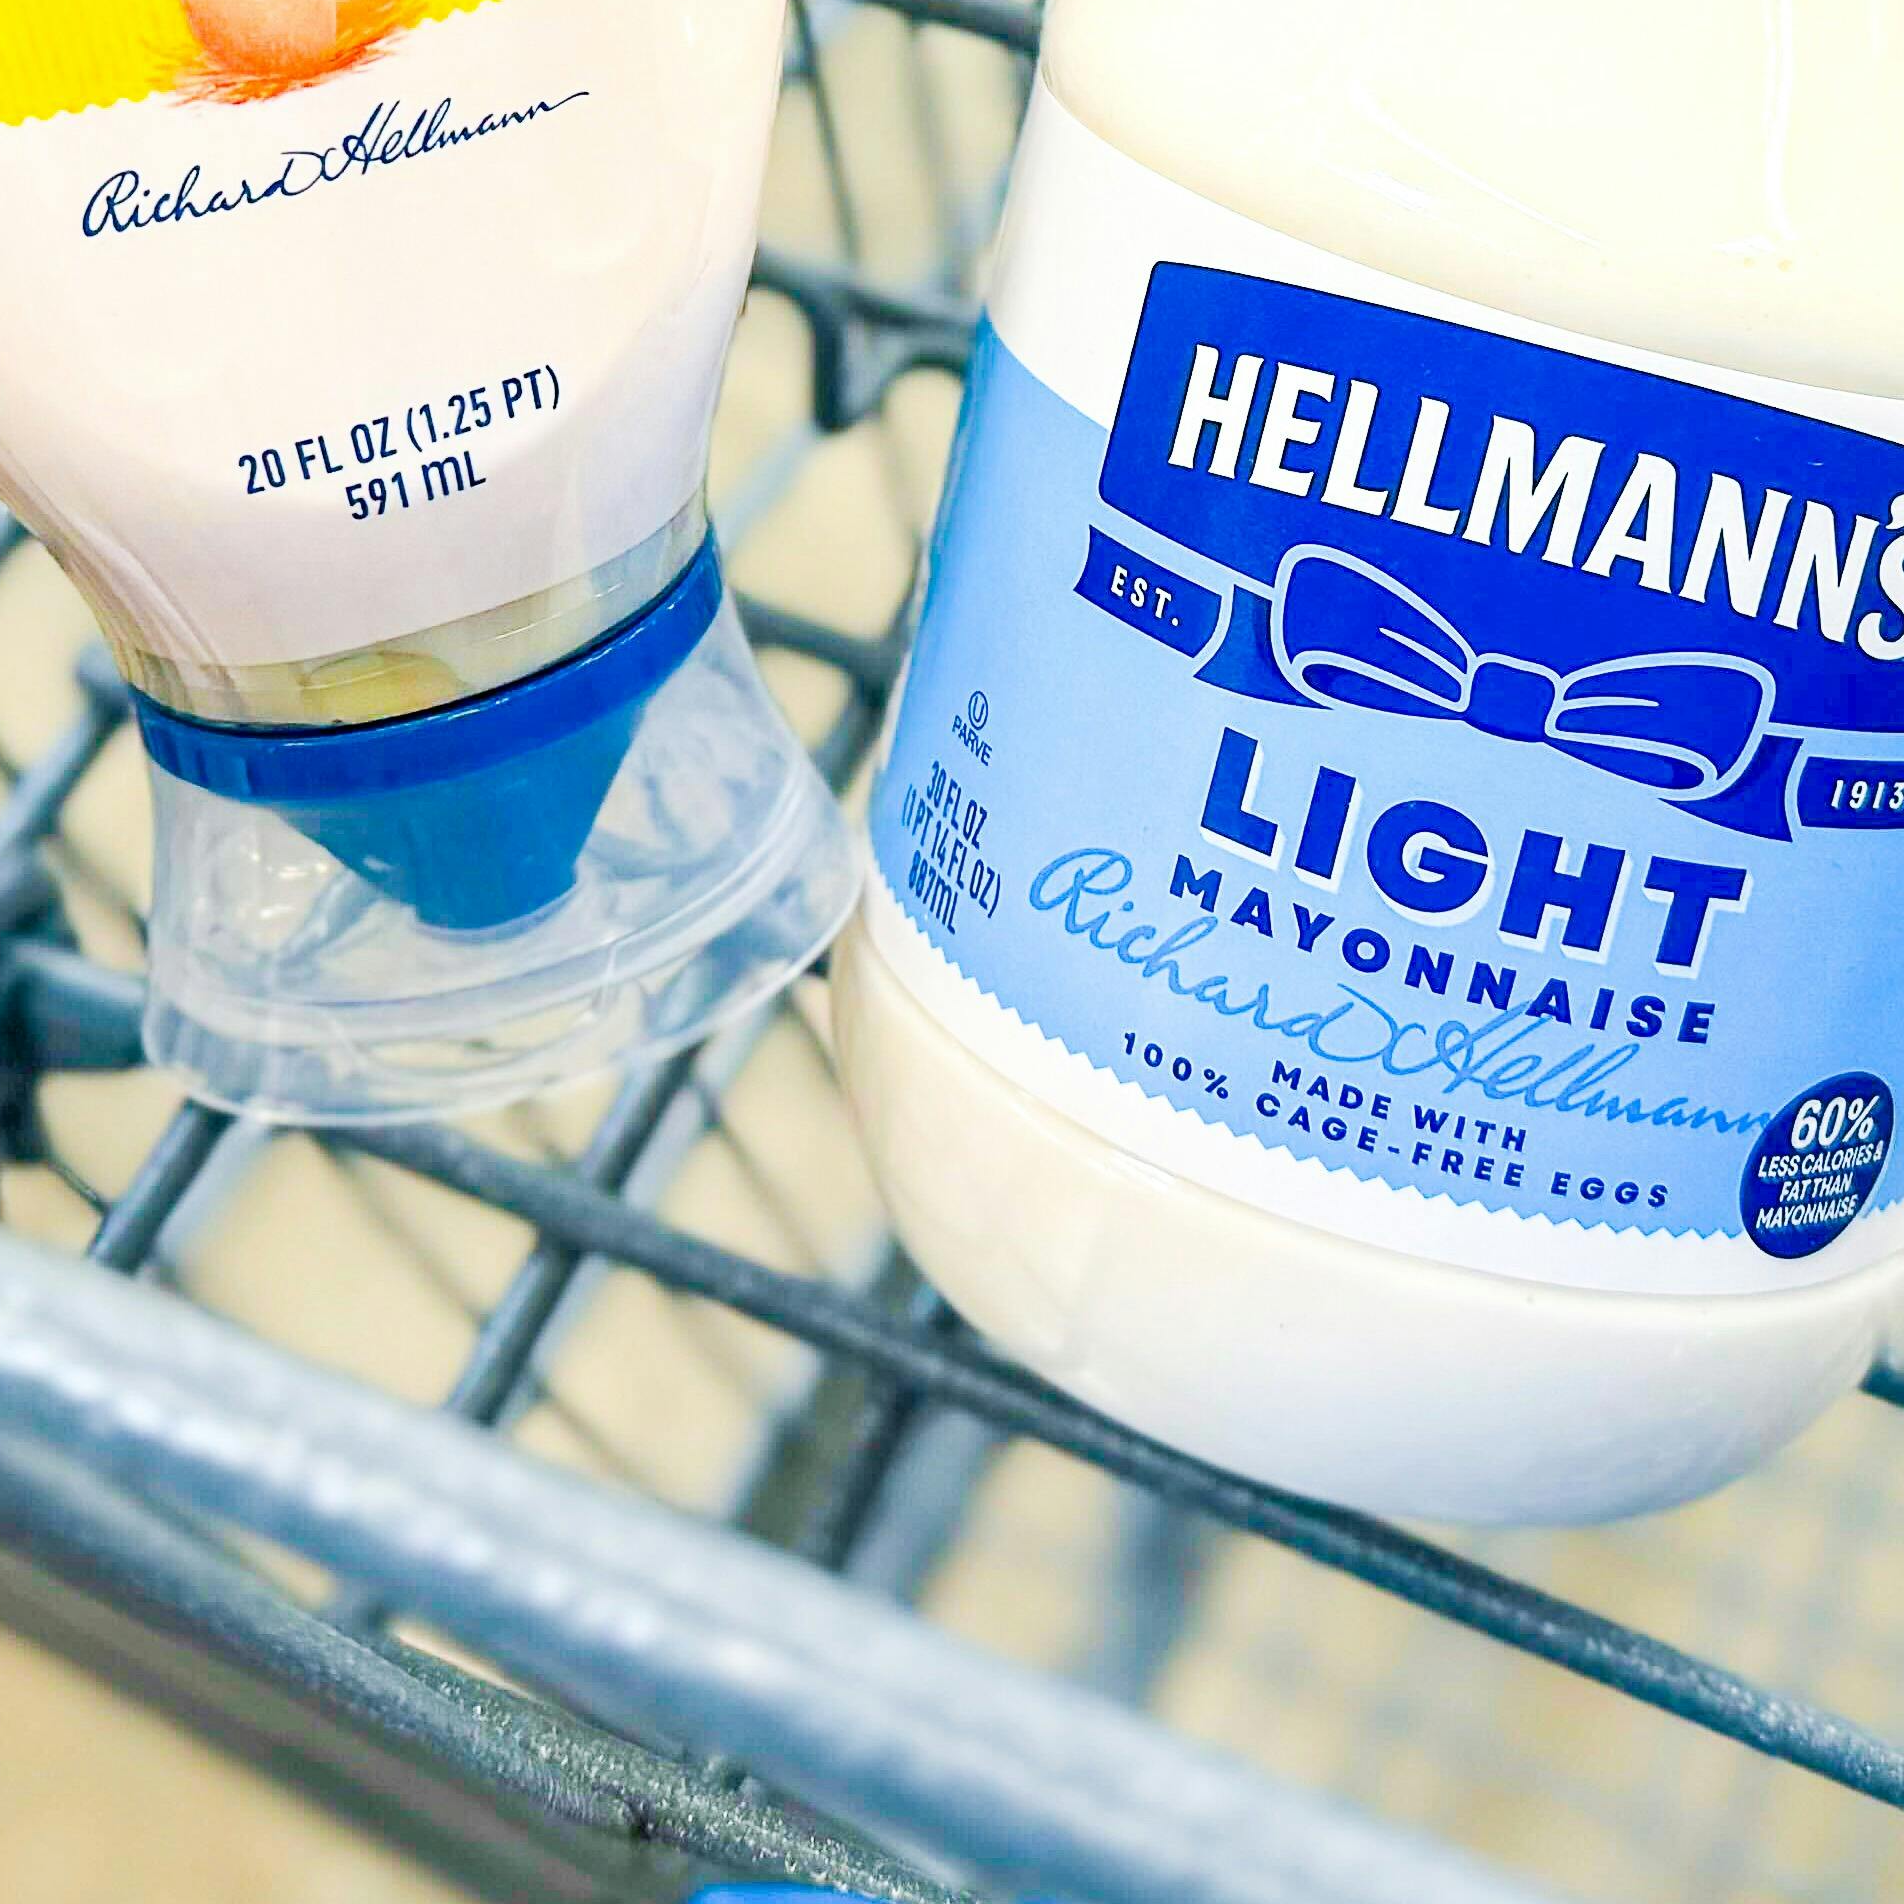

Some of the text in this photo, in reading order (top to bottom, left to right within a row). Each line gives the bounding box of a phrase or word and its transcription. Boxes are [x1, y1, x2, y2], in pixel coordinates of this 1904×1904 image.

[81, 91, 590, 237] Richard Hellmann
[238, 364, 560, 495] 20 FL OZ (1.25 PT)
[345, 471, 409, 520] 591
[1110, 565, 1179, 627] EST.
[951, 714, 993, 767] PARVE
[926, 760, 988, 850] 30 FL OZ
[1200, 726, 1751, 973] LIGHT
[912, 798, 933, 847] PT
[931, 820, 949, 868] 14
[947, 838, 967, 890] FL
[969, 859, 1001, 919] OZ)
[1169, 853, 1716, 1046] MAYONNAISE
[1123, 1031, 1669, 1209] 100% CAGE-FREE EGGS
[1272, 1060, 1527, 1153] MADE WITH
[1791, 1095, 1880, 1150] 60%
[1757, 1154, 1800, 1178] LESS
[1800, 1142, 1874, 1174] CALORIES
[1779, 1172, 1854, 1203] FAT THAN
[1755, 1194, 1859, 1230] MAYONNAISE
